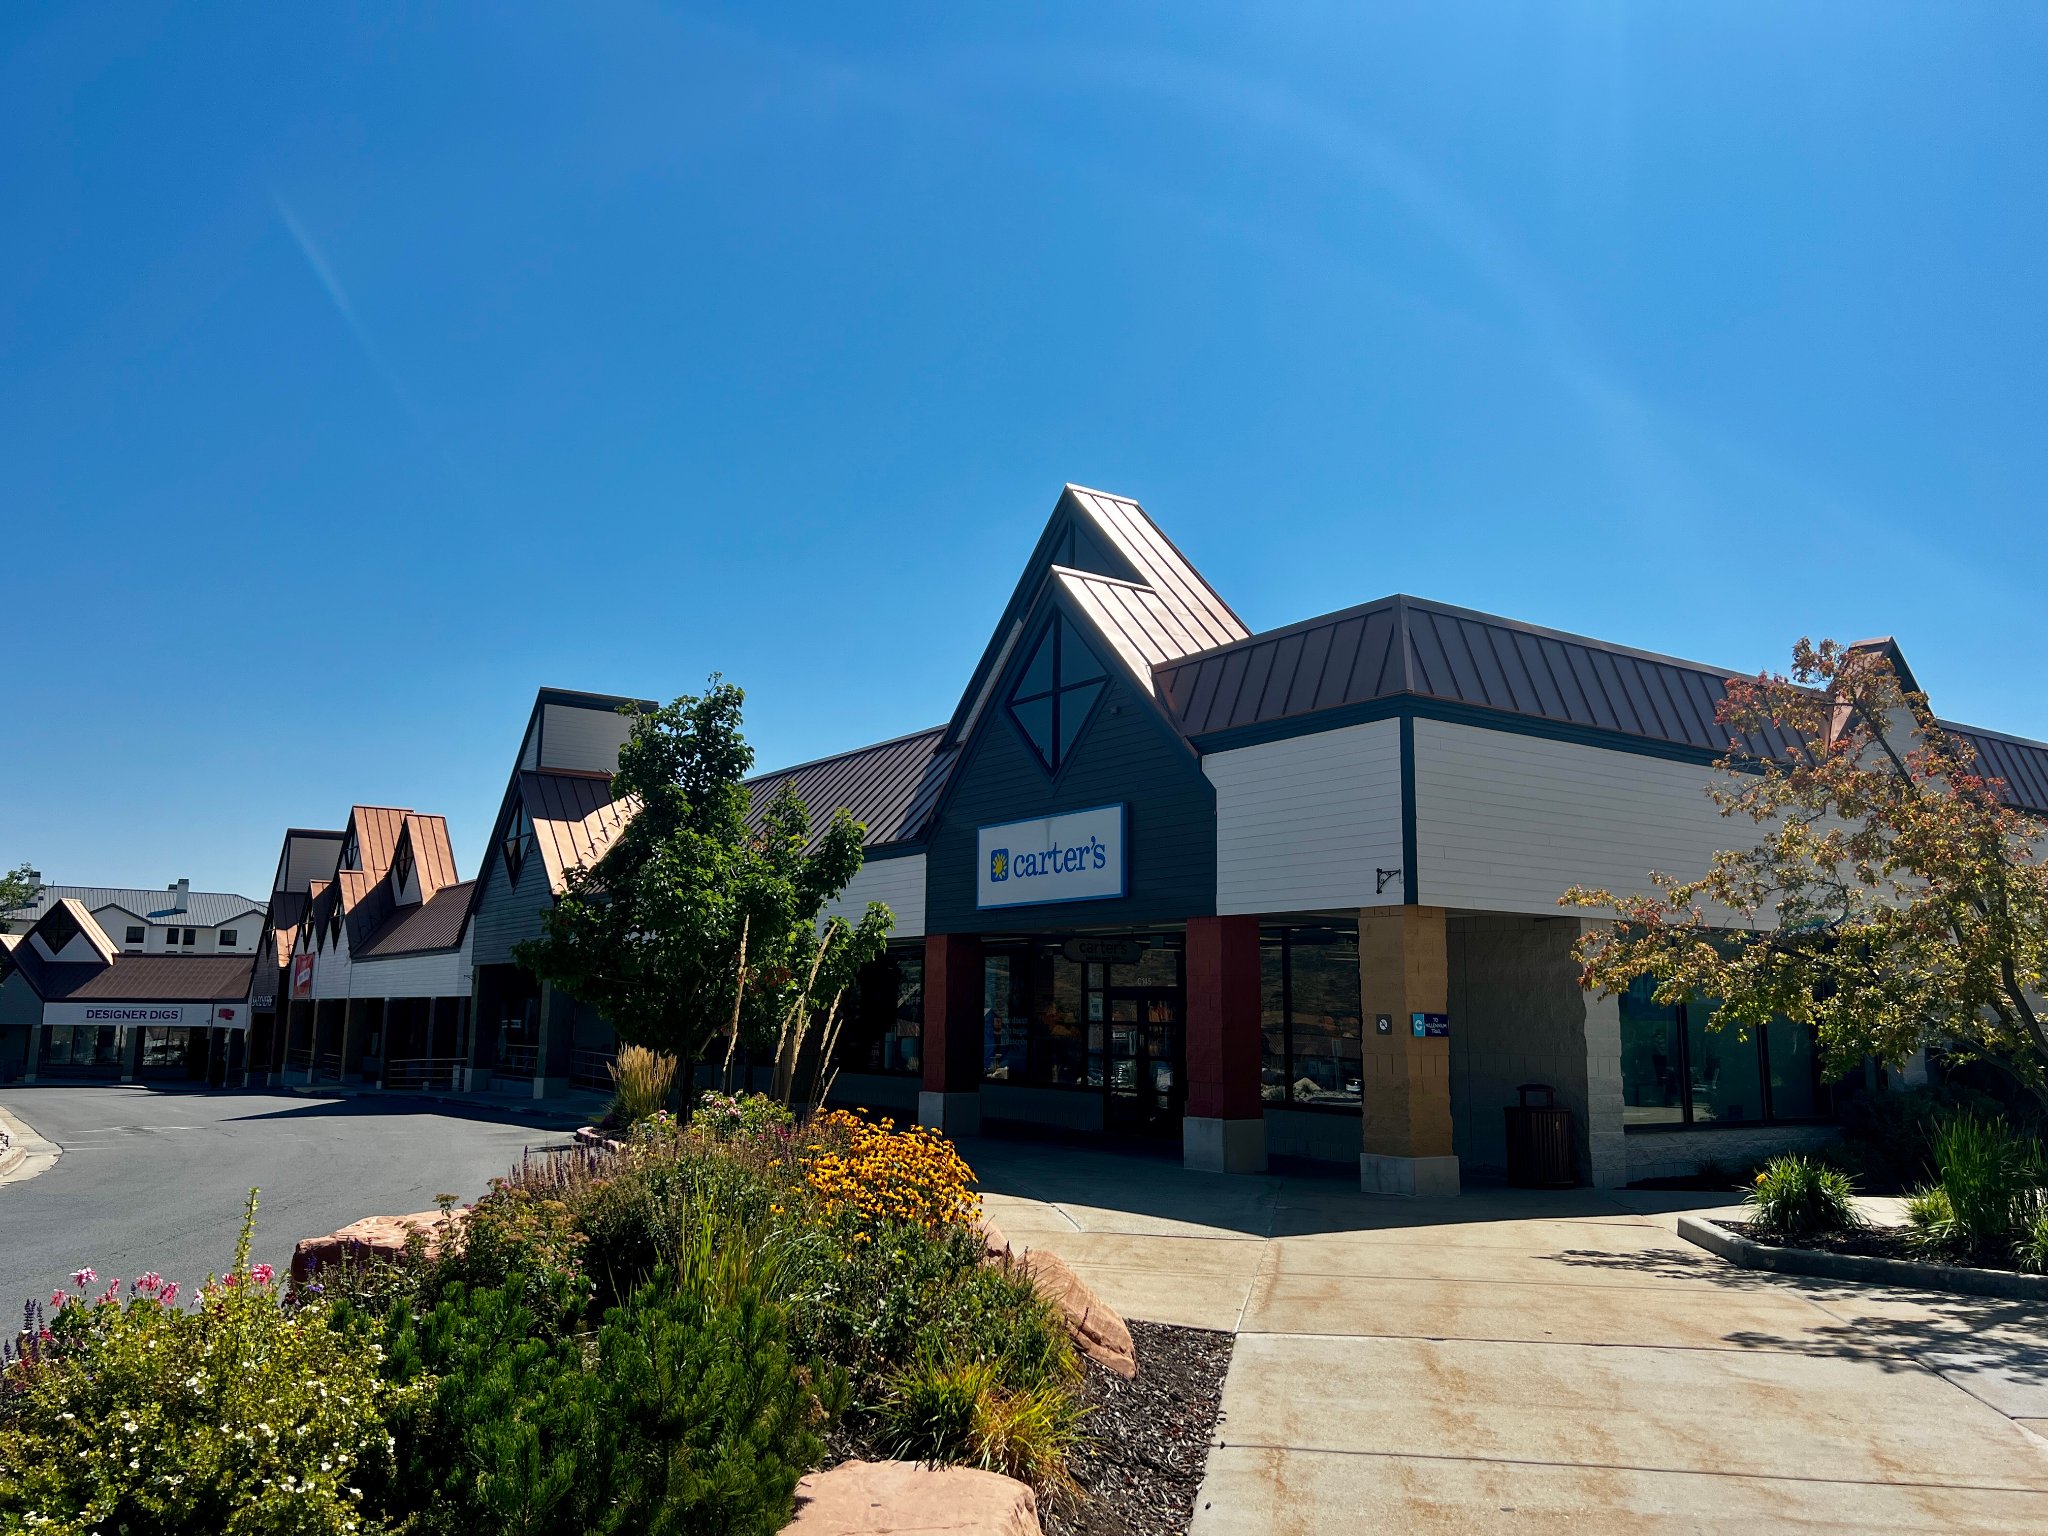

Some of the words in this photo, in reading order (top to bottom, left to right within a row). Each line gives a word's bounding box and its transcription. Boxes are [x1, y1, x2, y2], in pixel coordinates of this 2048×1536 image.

[1013, 836, 1106, 878] carter's
[86, 1009, 147, 1020] DESIGNER
[149, 1010, 179, 1020] DIGS
